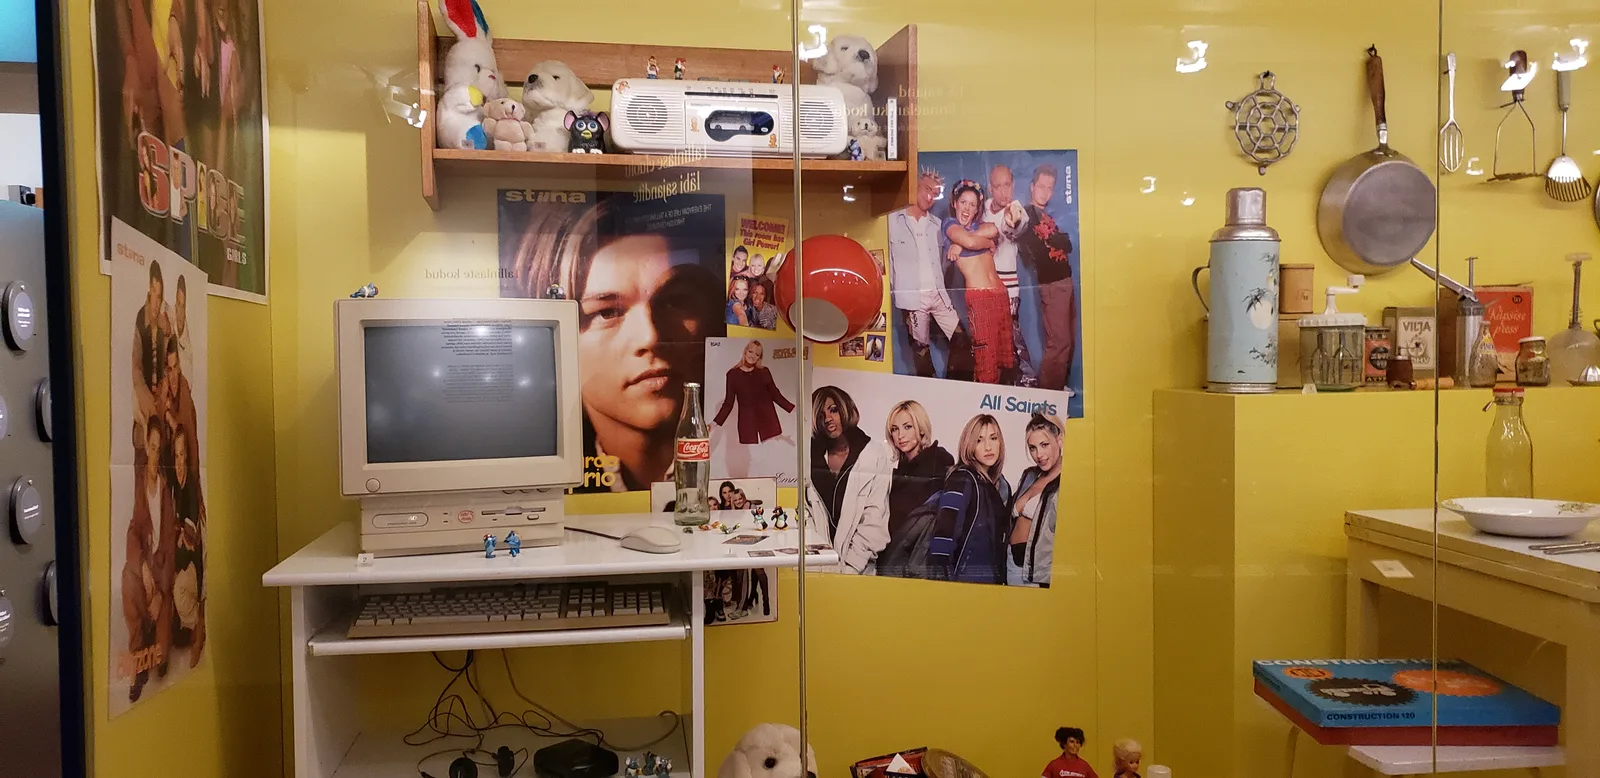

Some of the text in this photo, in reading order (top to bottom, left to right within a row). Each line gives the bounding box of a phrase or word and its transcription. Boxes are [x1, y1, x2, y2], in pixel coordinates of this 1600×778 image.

[138, 130, 246, 249] SPICE
[741, 217, 786, 235] WELCOME!
[740, 228, 785, 243] This room has
[743, 237, 780, 251] Girl Power!
[226, 247, 247, 265] GIRLS
[1402, 321, 1432, 335] VILJA
[979, 393, 1057, 416] All Saints
[585, 452, 618, 469] rdo
[584, 468, 616, 488] rio
[775, 471, 798, 483] Emm
[1326, 712, 1416, 721] CONSTRUCTION 120
